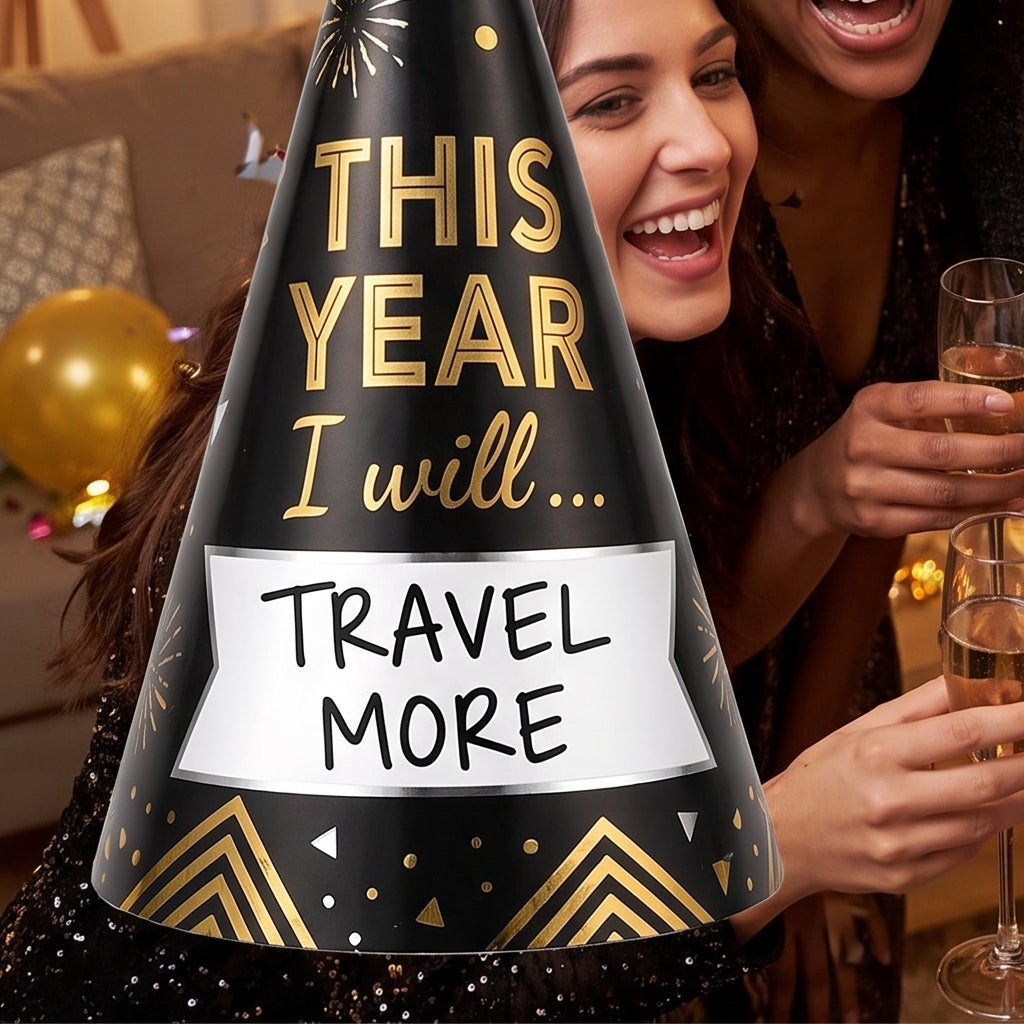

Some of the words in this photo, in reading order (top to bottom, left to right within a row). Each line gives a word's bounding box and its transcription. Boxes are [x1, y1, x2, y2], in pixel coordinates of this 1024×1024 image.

[315, 136, 562, 253] THIS
[289, 274, 594, 391] YEAR
[281, 414, 346, 520] I
[362, 410, 605, 512] will...
[261, 581, 611, 670] TRAVEL
[322, 684, 567, 770] MORE
